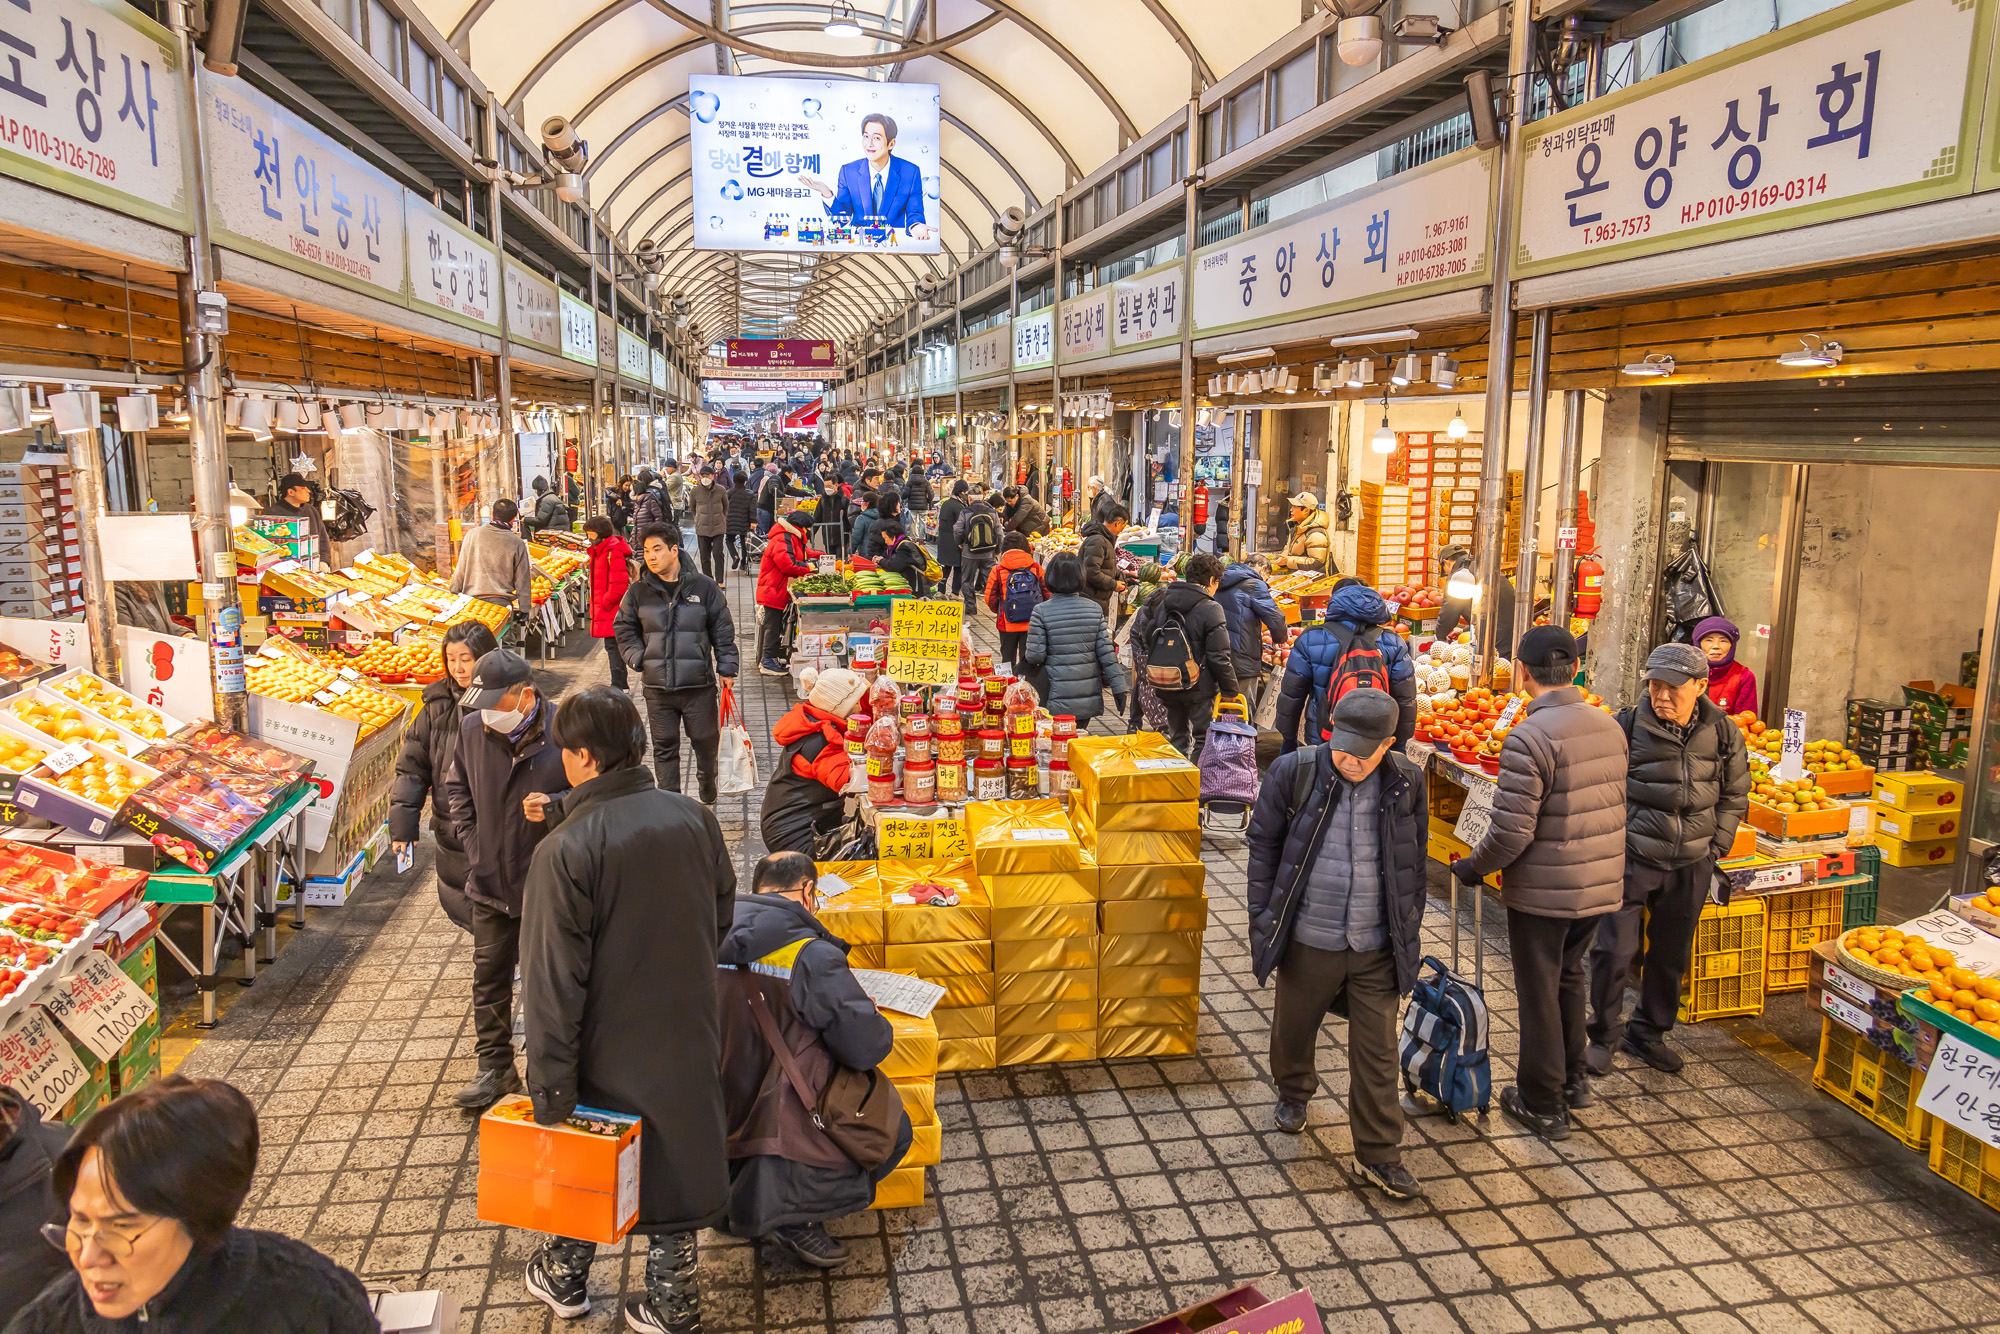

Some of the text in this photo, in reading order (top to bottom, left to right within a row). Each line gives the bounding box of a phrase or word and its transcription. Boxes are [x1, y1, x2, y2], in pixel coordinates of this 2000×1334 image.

[718, 121, 736, 129] 정겨운
[738, 122, 756, 130] 시장을
[758, 122, 776, 130] 방문한
[778, 123, 790, 131] 손님
[718, 130, 810, 140] 시장의 정을 지키는 사장님 곁에도
[1542, 114, 1616, 158] 청과위탁판매
[1564, 49, 1881, 228] 온양상회
[23, 125, 117, 181] 010-3126-7289
[708, 145, 820, 178] 당신 곁에 함께
[254, 128, 381, 264] 천안농산
[748, 187, 811, 198] MG 새마을금고
[1681, 174, 1828, 225] H.P 010-9169-0314
[1433, 214, 1470, 237] 967-9161
[1595, 214, 1651, 243] 963-7573
[1239, 209, 1390, 307] 중앙상회
[1410, 236, 1468, 265] 010-6285-3081
[1410, 258, 1467, 284] 010-6738-7005
[888, 660, 939, 682] 어리굴젓
[302, 728, 335, 746] 공동포장
[132, 812, 159, 832] 사과
[886, 820, 909, 838] 명란
[1848, 980, 1863, 996] 포도
[1846, 1009, 1860, 1024] 포도
[1940, 1043, 2000, 1091] 한무데
